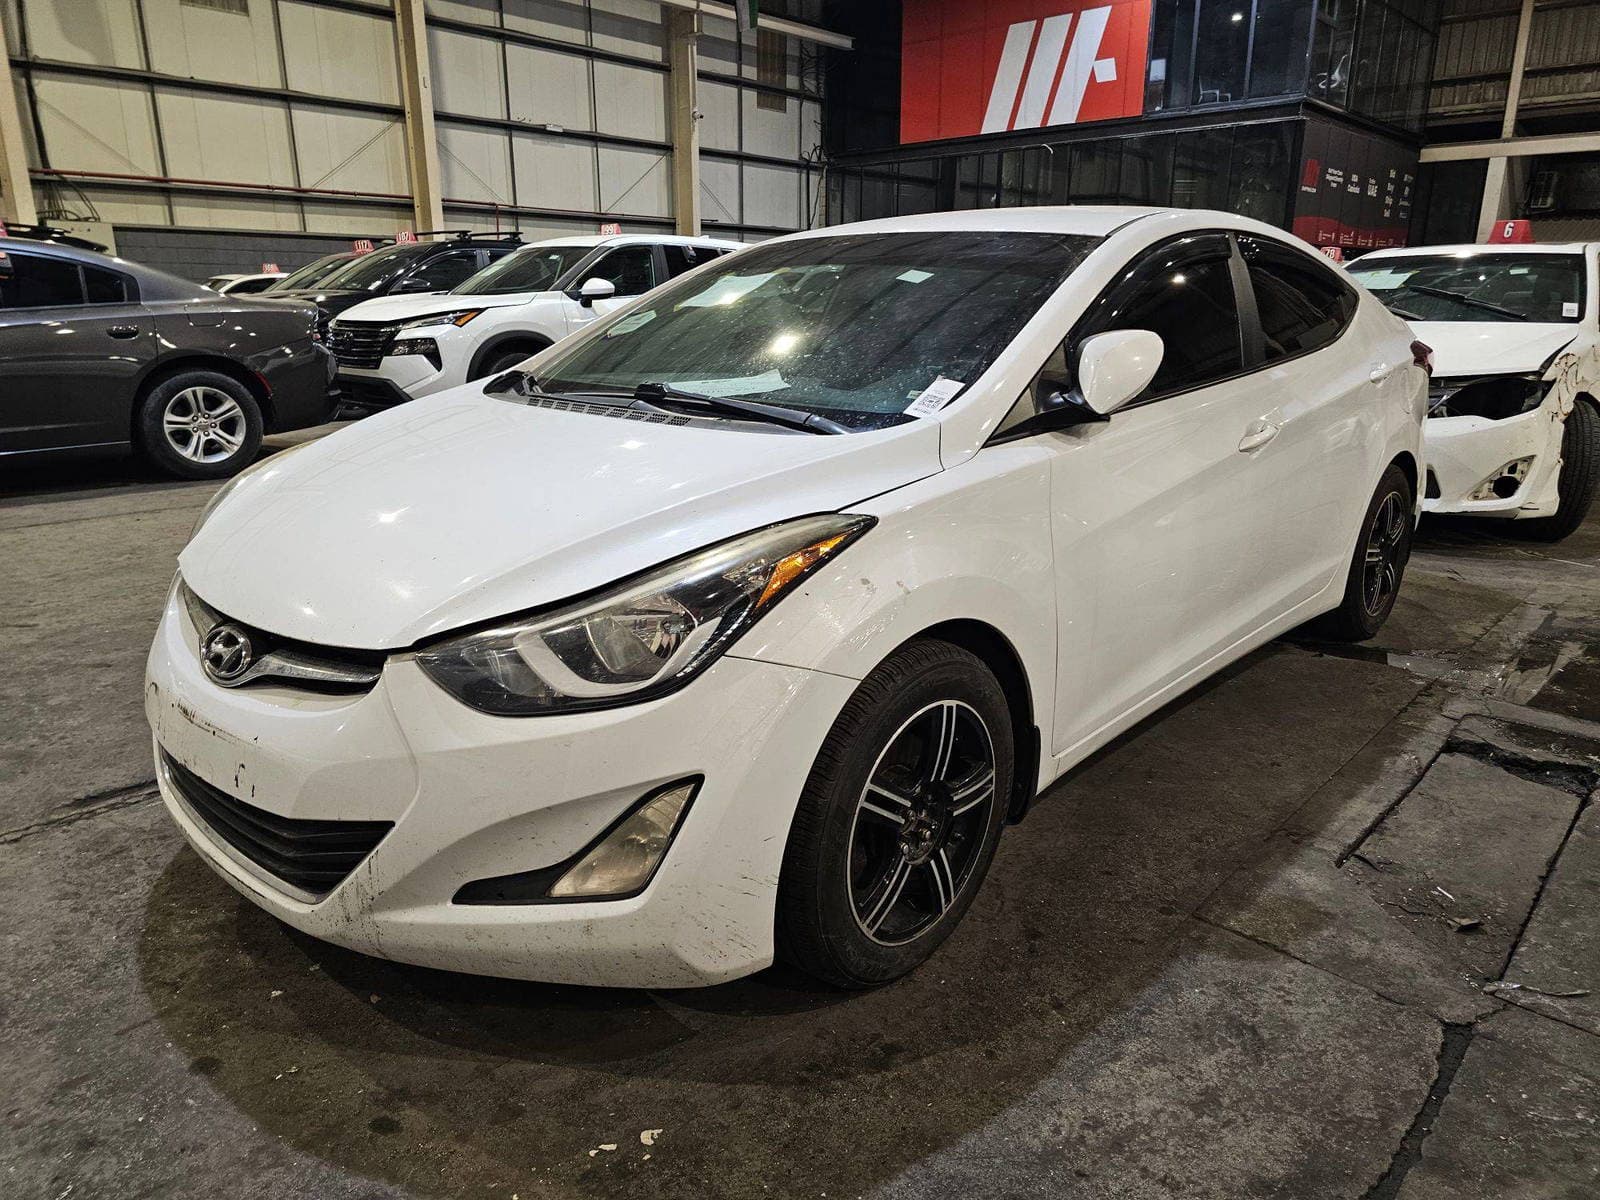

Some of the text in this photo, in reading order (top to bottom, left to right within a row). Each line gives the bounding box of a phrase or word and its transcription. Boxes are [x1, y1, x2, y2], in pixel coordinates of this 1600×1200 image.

[1503, 222, 1515, 238] 6
[398, 231, 409, 241] 107
[358, 240, 368, 250] 117
[1325, 248, 1335, 258] 78
